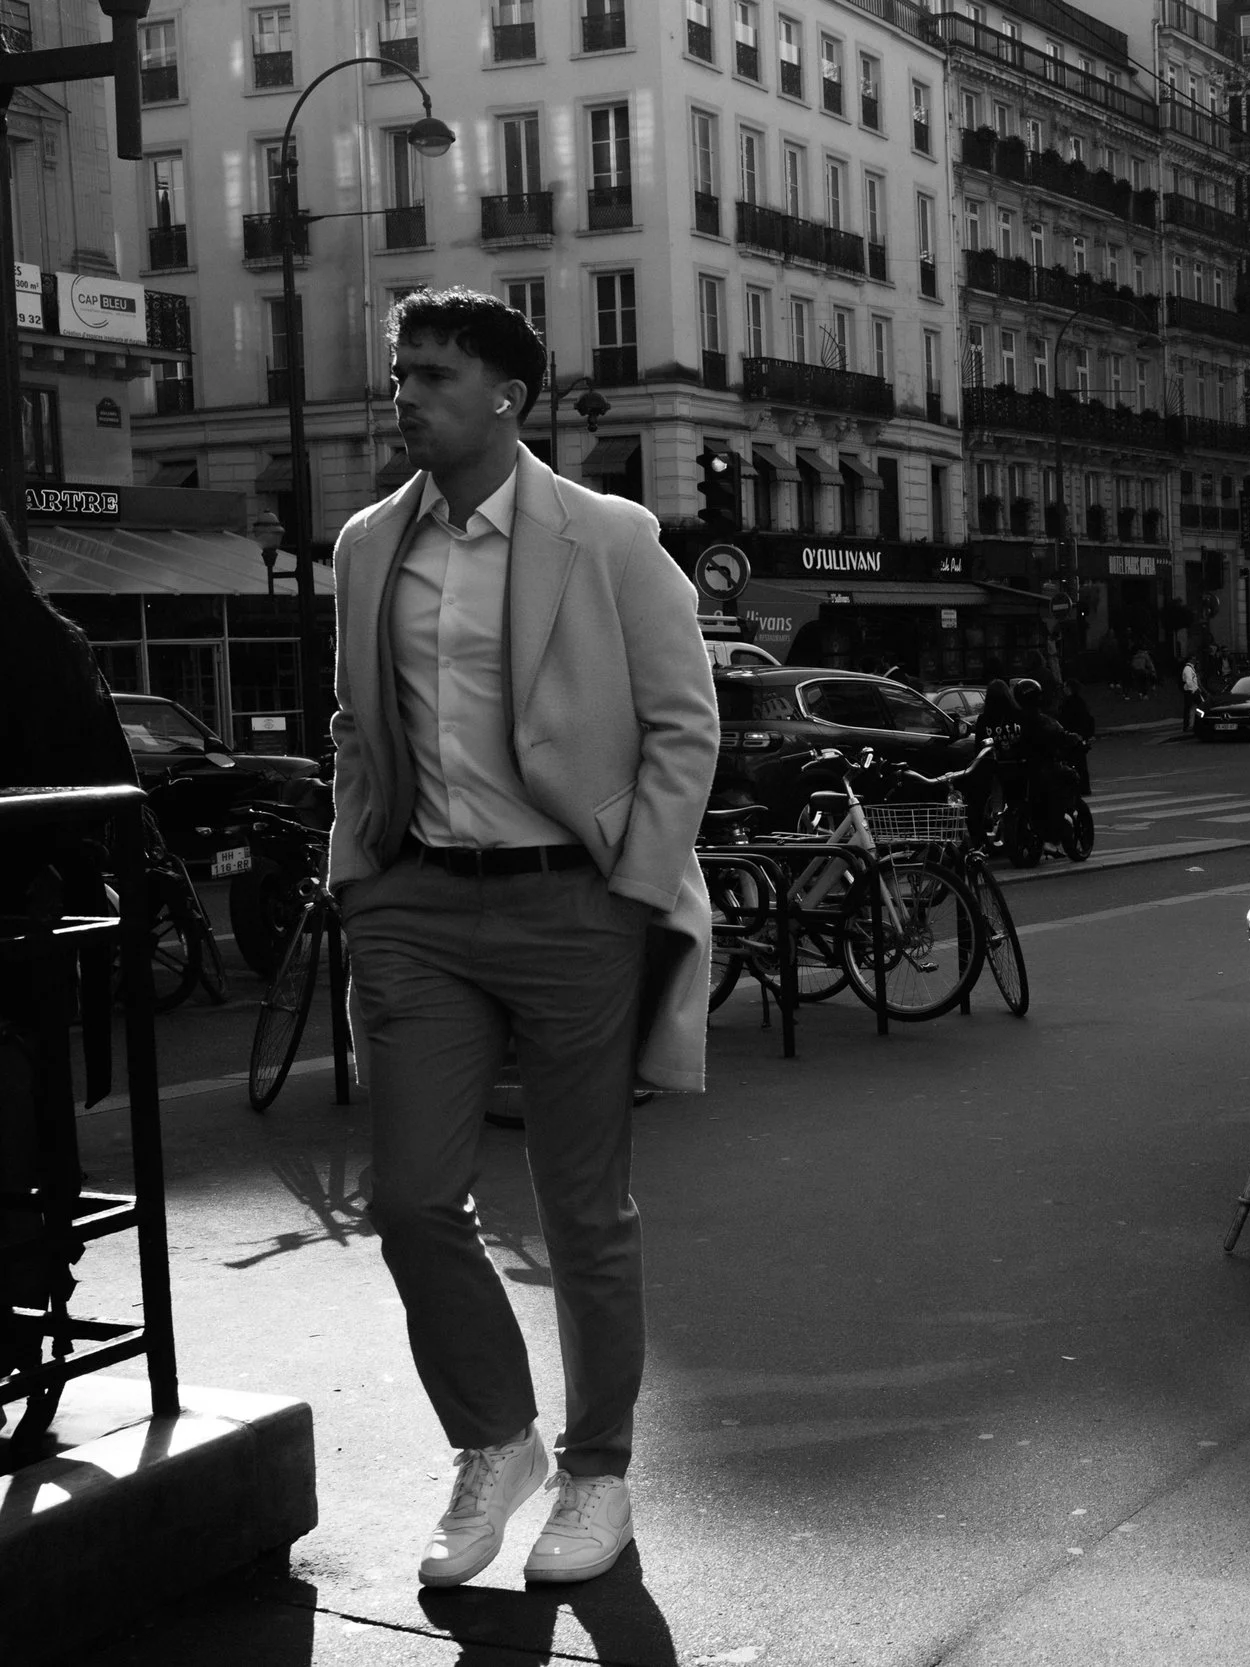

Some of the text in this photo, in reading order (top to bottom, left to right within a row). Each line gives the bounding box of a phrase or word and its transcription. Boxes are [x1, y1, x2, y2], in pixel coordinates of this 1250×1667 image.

[78, 293, 128, 310] CAP BLEU
[28, 314, 42, 325] 32
[802, 547, 882, 572] O'SULLIVANS
